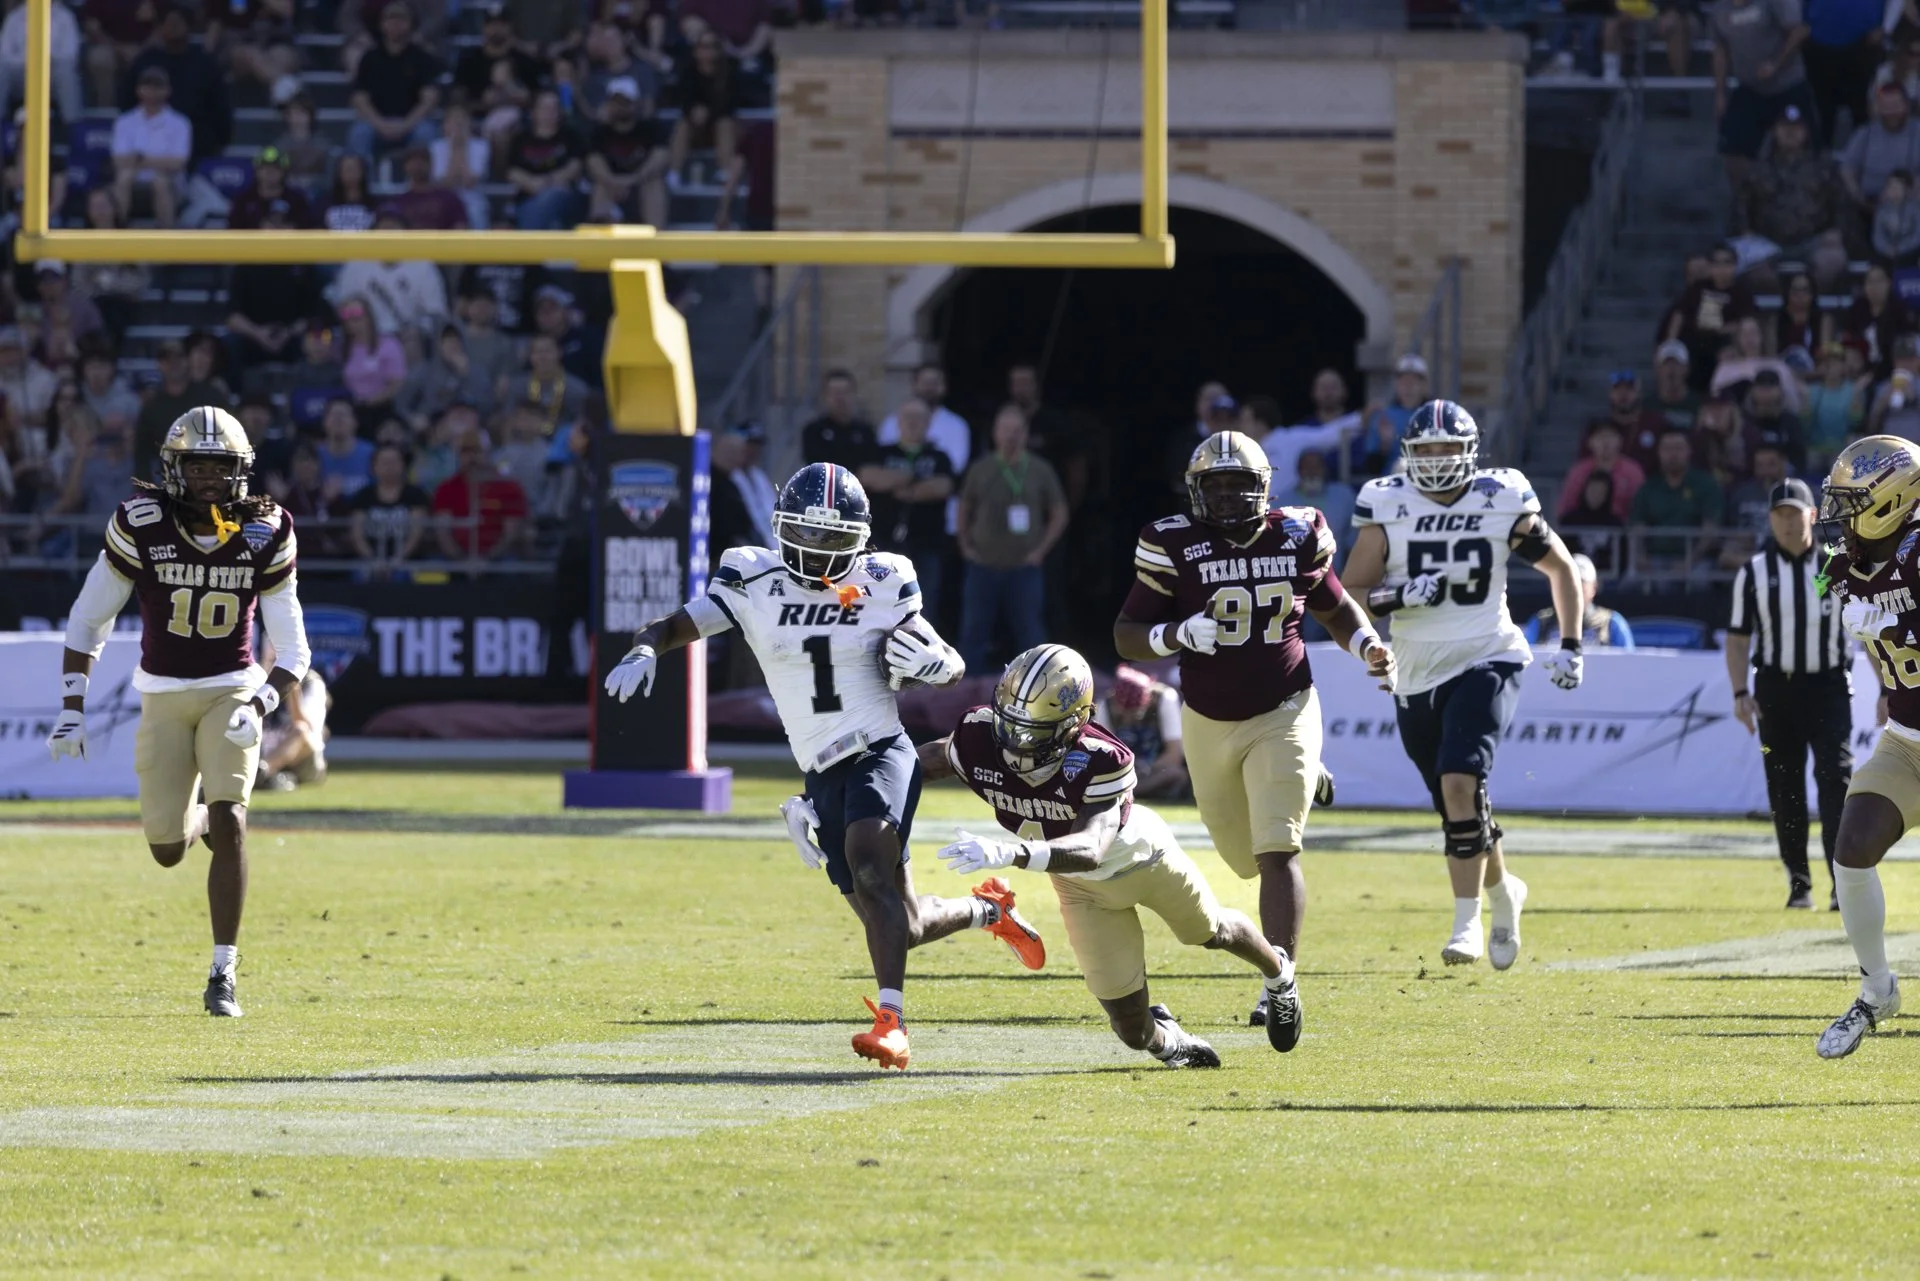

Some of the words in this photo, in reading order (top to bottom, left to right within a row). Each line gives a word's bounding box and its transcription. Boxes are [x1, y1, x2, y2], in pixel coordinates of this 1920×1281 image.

[1415, 514, 1483, 532] RICE
[149, 545, 178, 560] SBC
[1183, 541, 1213, 561] SBC
[155, 564, 206, 587] TEXAS
[208, 566, 255, 589] STATE
[1199, 558, 1248, 584] TEXAS
[1251, 556, 1297, 578] STATE
[1407, 538, 1493, 607] 53
[167, 588, 240, 639] 10
[777, 603, 865, 626] RICE
[1209, 580, 1295, 646] 97
[1873, 586, 1917, 615] STATE
[372, 617, 464, 677] THE
[802, 634, 843, 714] 1
[973, 766, 1004, 785] SBC
[983, 788, 1034, 819] TEXAS
[1033, 799, 1077, 821] STATE
